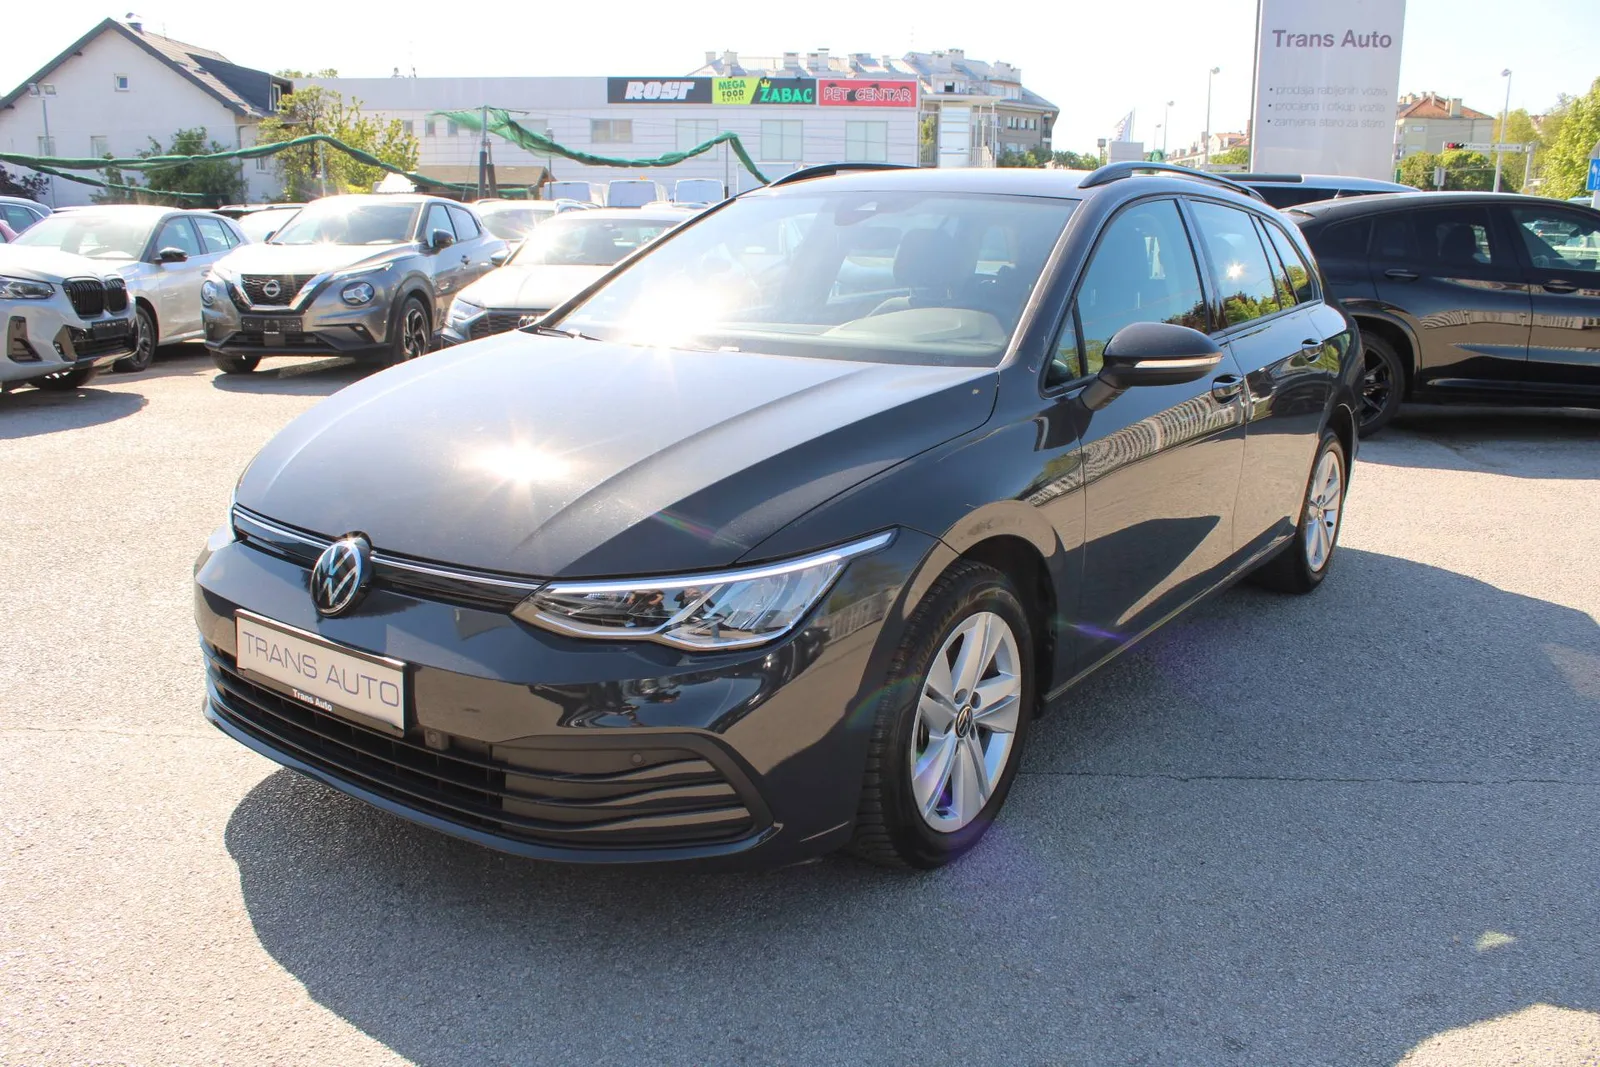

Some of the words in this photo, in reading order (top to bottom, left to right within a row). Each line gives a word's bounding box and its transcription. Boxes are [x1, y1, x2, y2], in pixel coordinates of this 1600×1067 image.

[1272, 29, 1334, 48] Trans
[1341, 29, 1392, 48] Auto
[718, 80, 746, 90] MEGA
[722, 90, 744, 98] FOOD
[823, 87, 850, 101] PET
[854, 87, 912, 102] CENTAR
[242, 631, 318, 679] TRANS
[325, 664, 400, 708] AUTO
[292, 688, 314, 704] Trans
[315, 697, 333, 712] Auto
